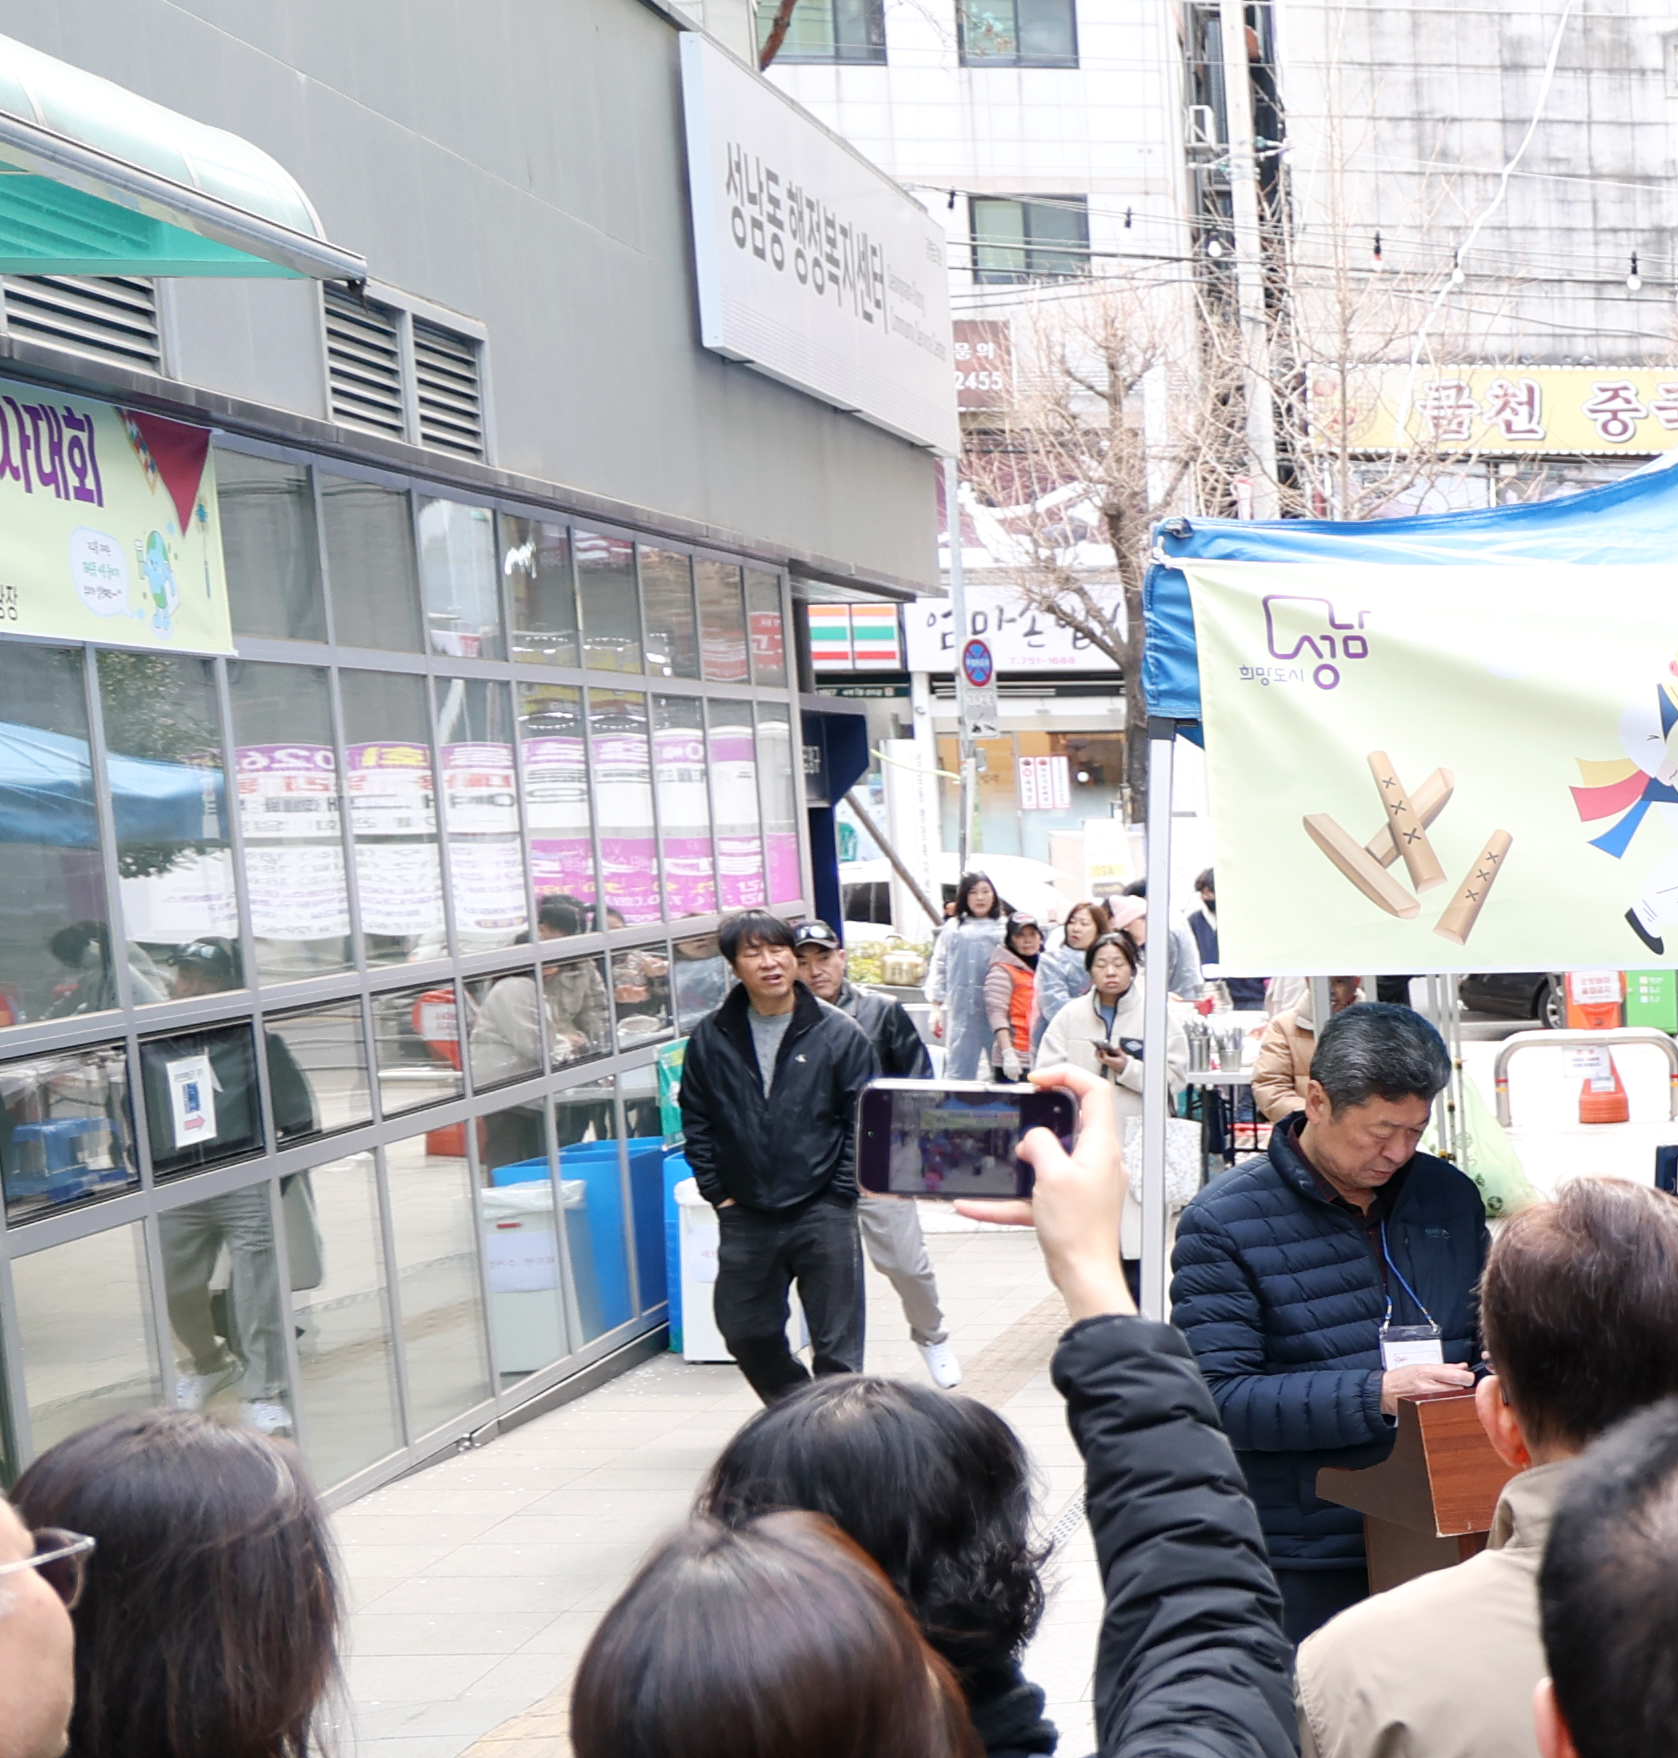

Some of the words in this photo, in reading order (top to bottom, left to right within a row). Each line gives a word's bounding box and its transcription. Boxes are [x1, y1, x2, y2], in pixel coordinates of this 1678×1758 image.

[725, 141, 786, 273] 성남동
[786, 180, 889, 336] 행정복지센터
[1239, 664, 1304, 687] 희망도시
